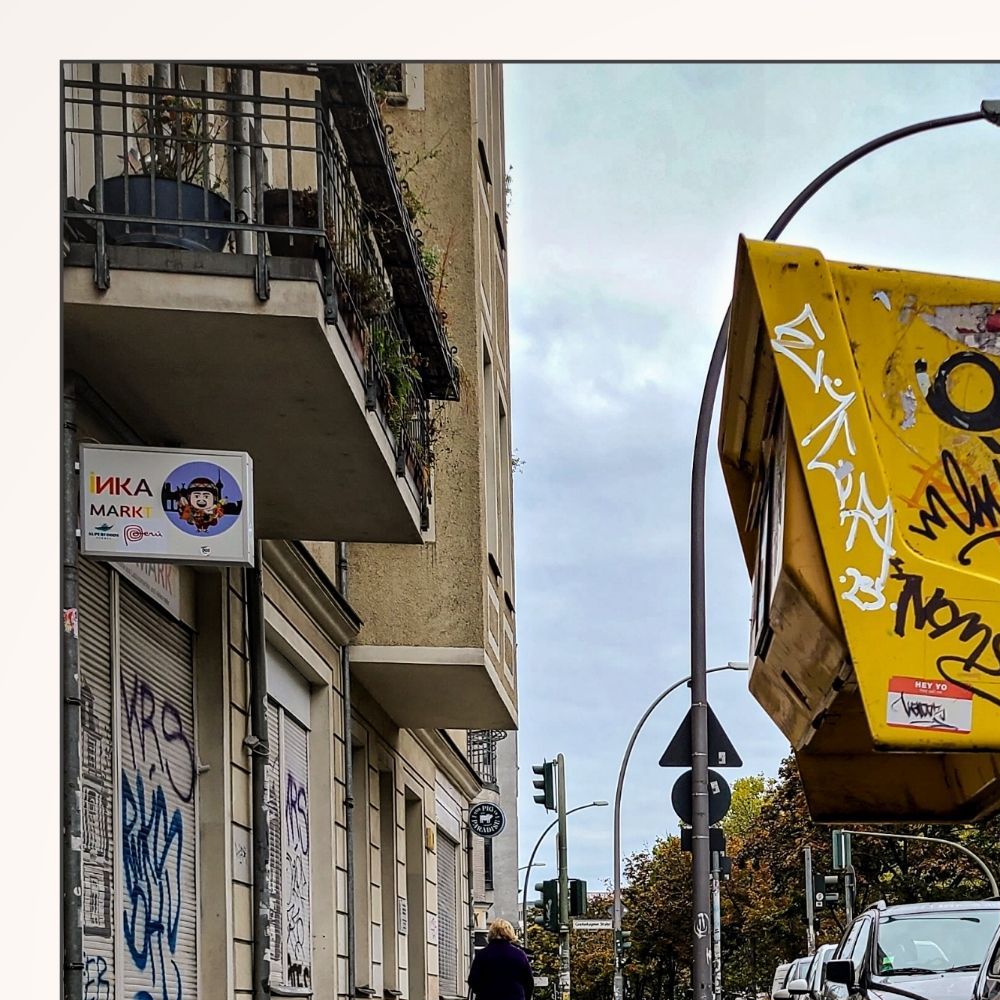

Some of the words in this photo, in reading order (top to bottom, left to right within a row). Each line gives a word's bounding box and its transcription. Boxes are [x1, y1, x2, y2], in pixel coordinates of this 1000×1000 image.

[89, 503, 153, 519] MARKT
[914, 681, 933, 690] HEY
[935, 683, 948, 691] YO
